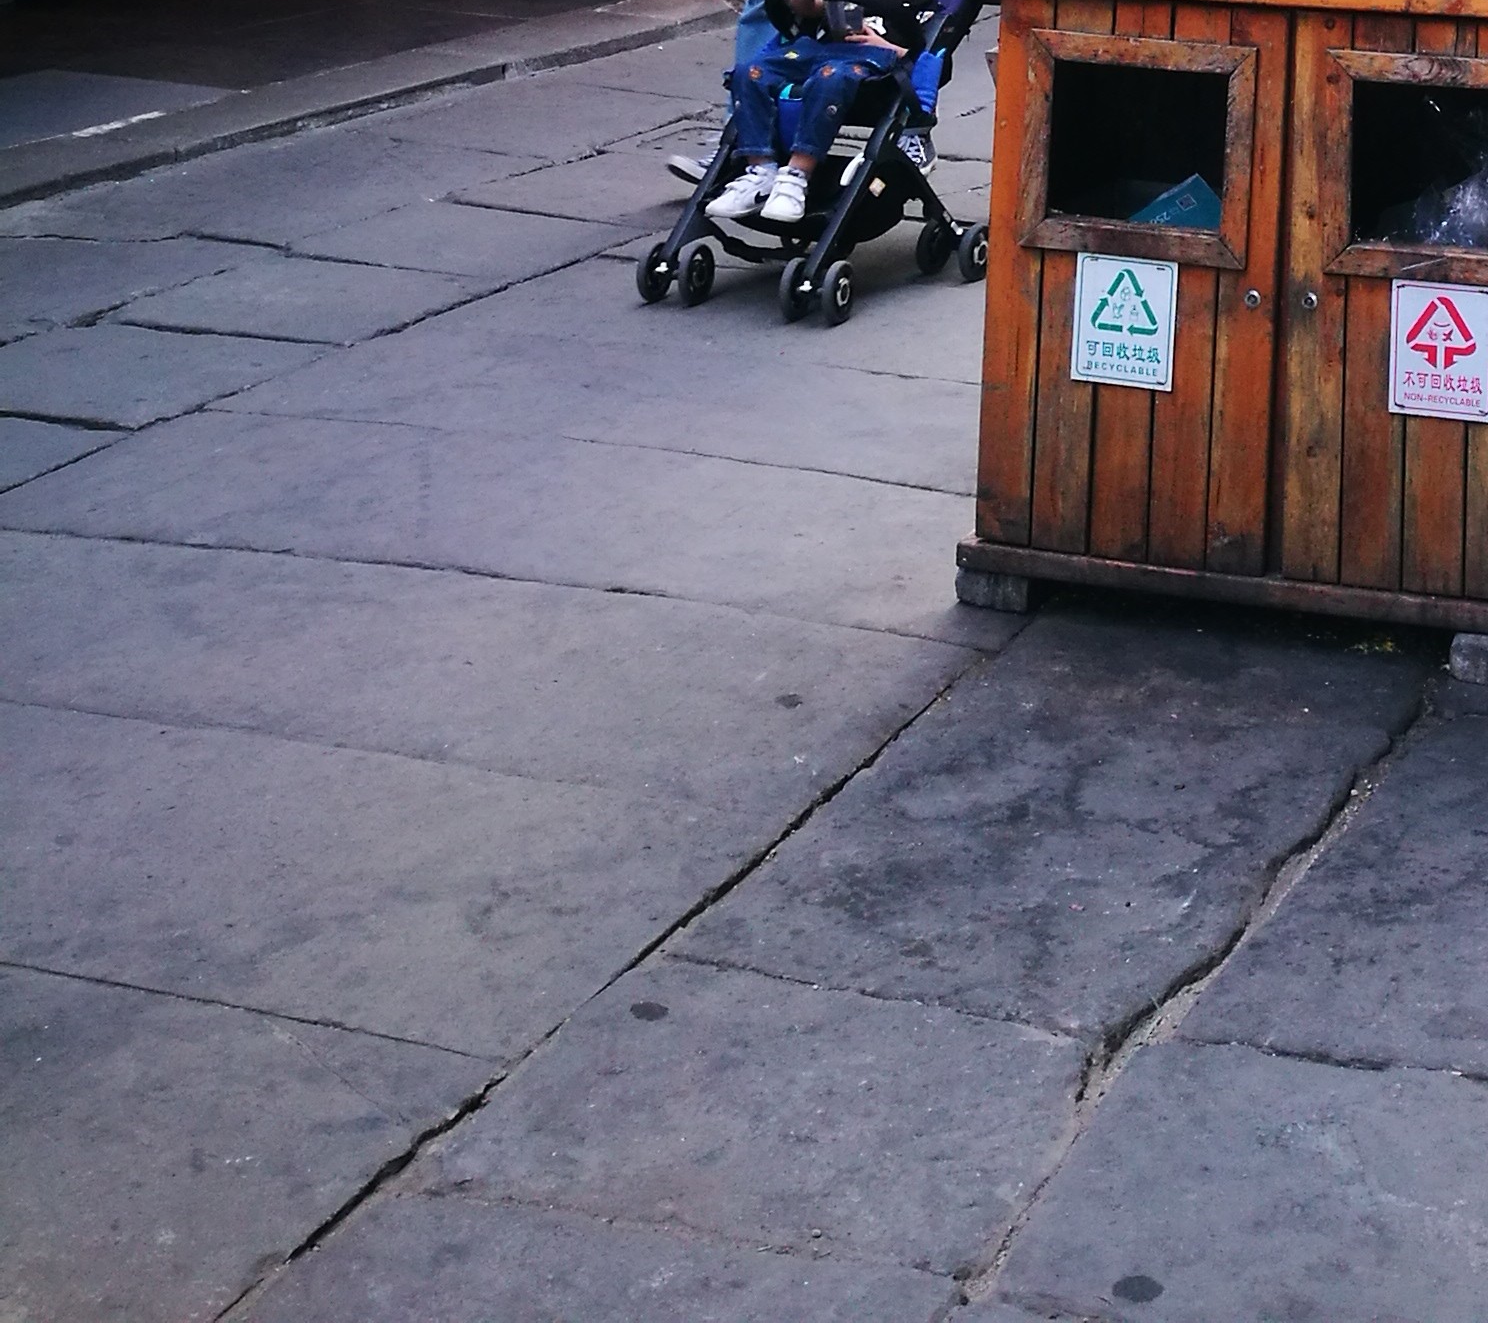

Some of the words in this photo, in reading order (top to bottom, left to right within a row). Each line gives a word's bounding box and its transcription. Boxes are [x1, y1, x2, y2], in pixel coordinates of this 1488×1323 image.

[1086, 339, 1162, 364] 可回收垃圾
[1403, 370, 1483, 395] 不可回收垃圾
[1403, 391, 1481, 408] NON-RECYCLABLE
